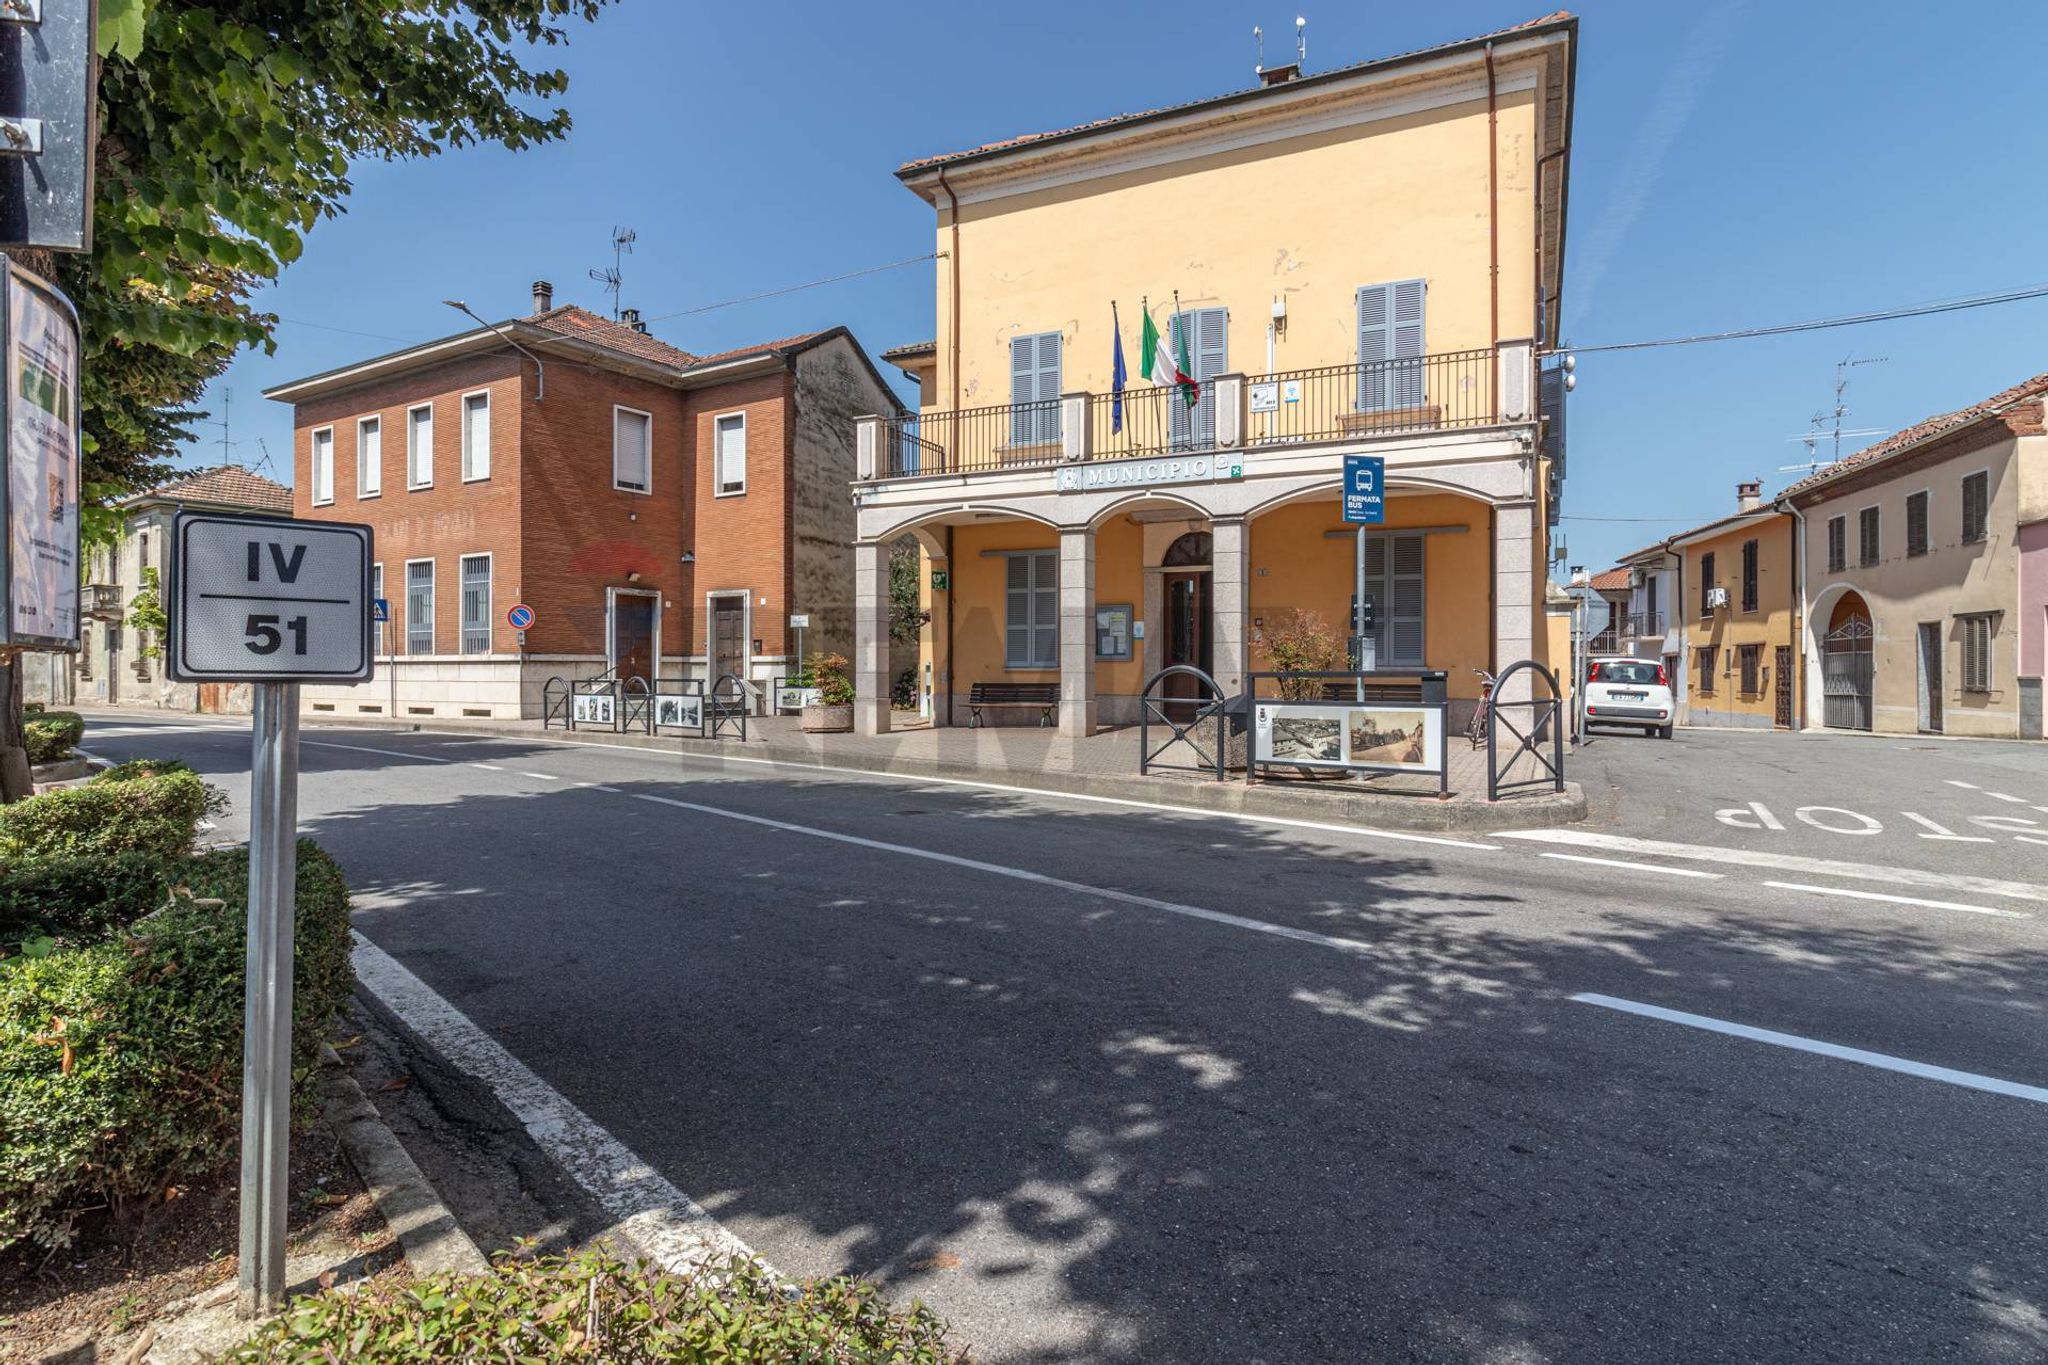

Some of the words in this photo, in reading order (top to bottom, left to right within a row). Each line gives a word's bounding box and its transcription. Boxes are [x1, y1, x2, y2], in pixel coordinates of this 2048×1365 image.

[1089, 460, 1207, 486] MUNICIPIO
[247, 541, 307, 584] IV
[244, 614, 307, 656] 51
